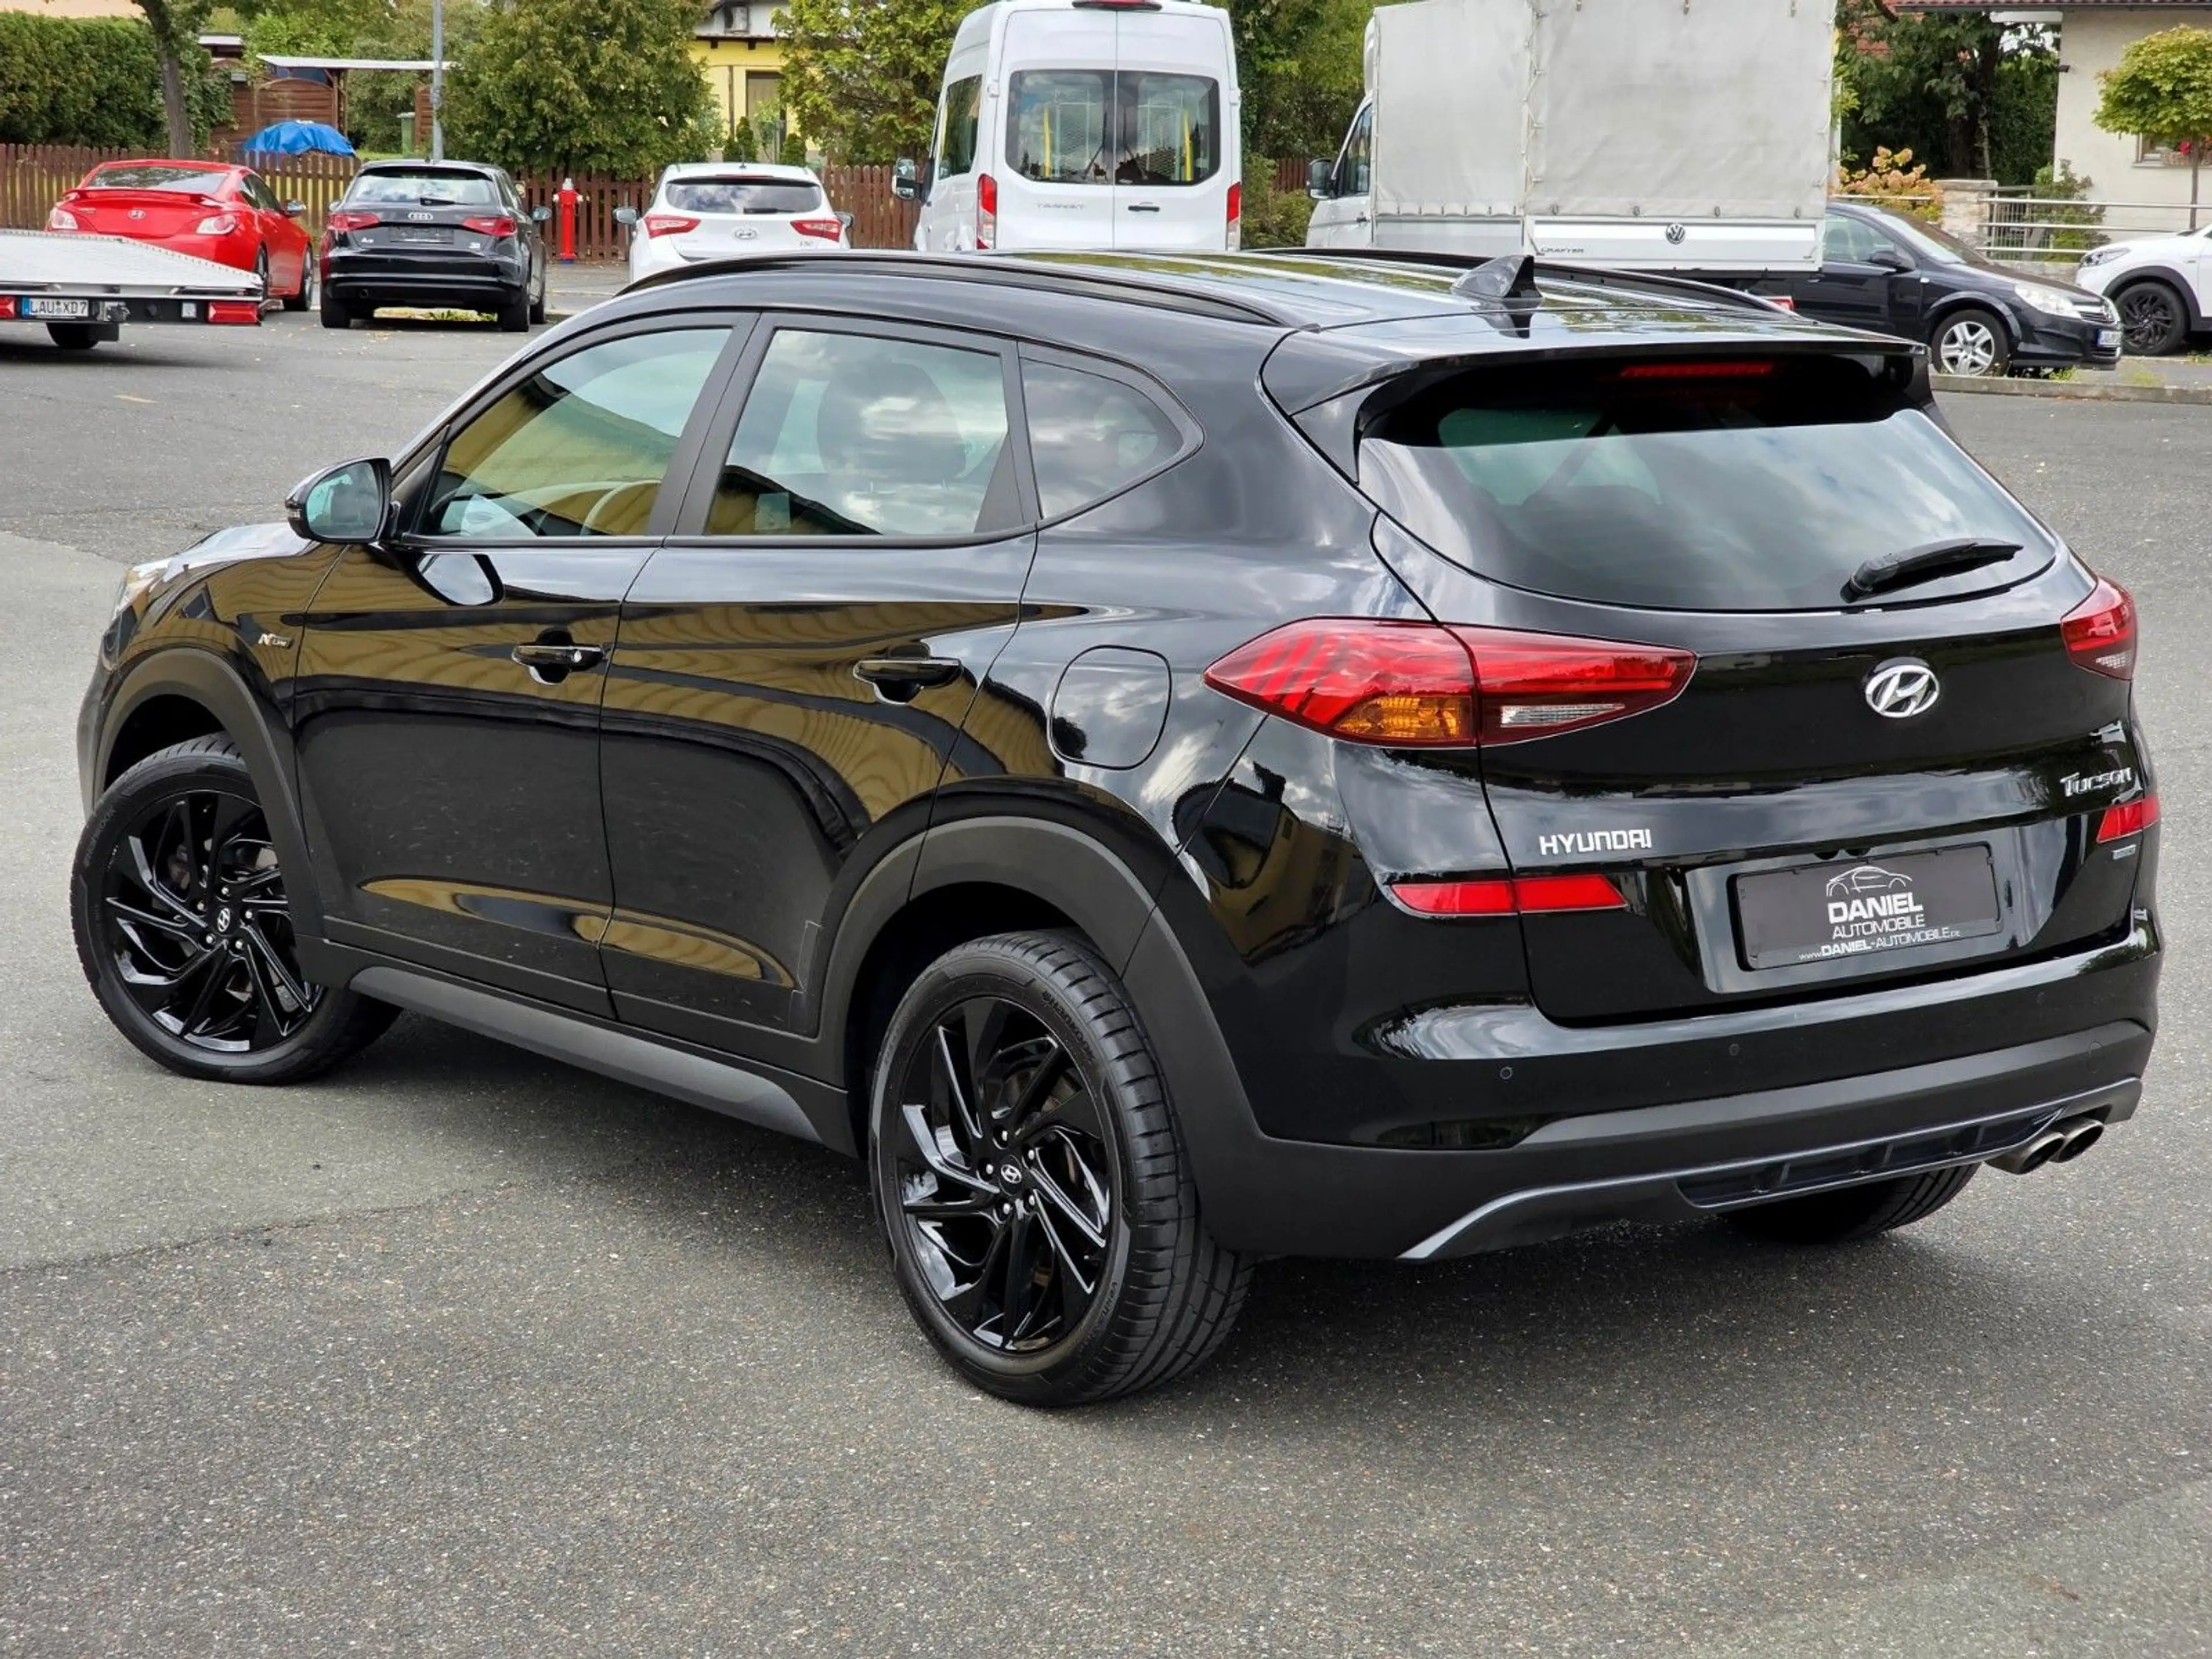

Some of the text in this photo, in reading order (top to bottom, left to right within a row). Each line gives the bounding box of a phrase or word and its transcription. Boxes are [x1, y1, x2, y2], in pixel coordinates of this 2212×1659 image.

[30, 301, 55, 313] LAU
[2059, 767, 2132, 797] Tucson
[1539, 828, 1652, 855] HYUNDAI
[1827, 891, 1923, 924] DANIEL
[1832, 913, 1926, 940] AUTOMOBILE
